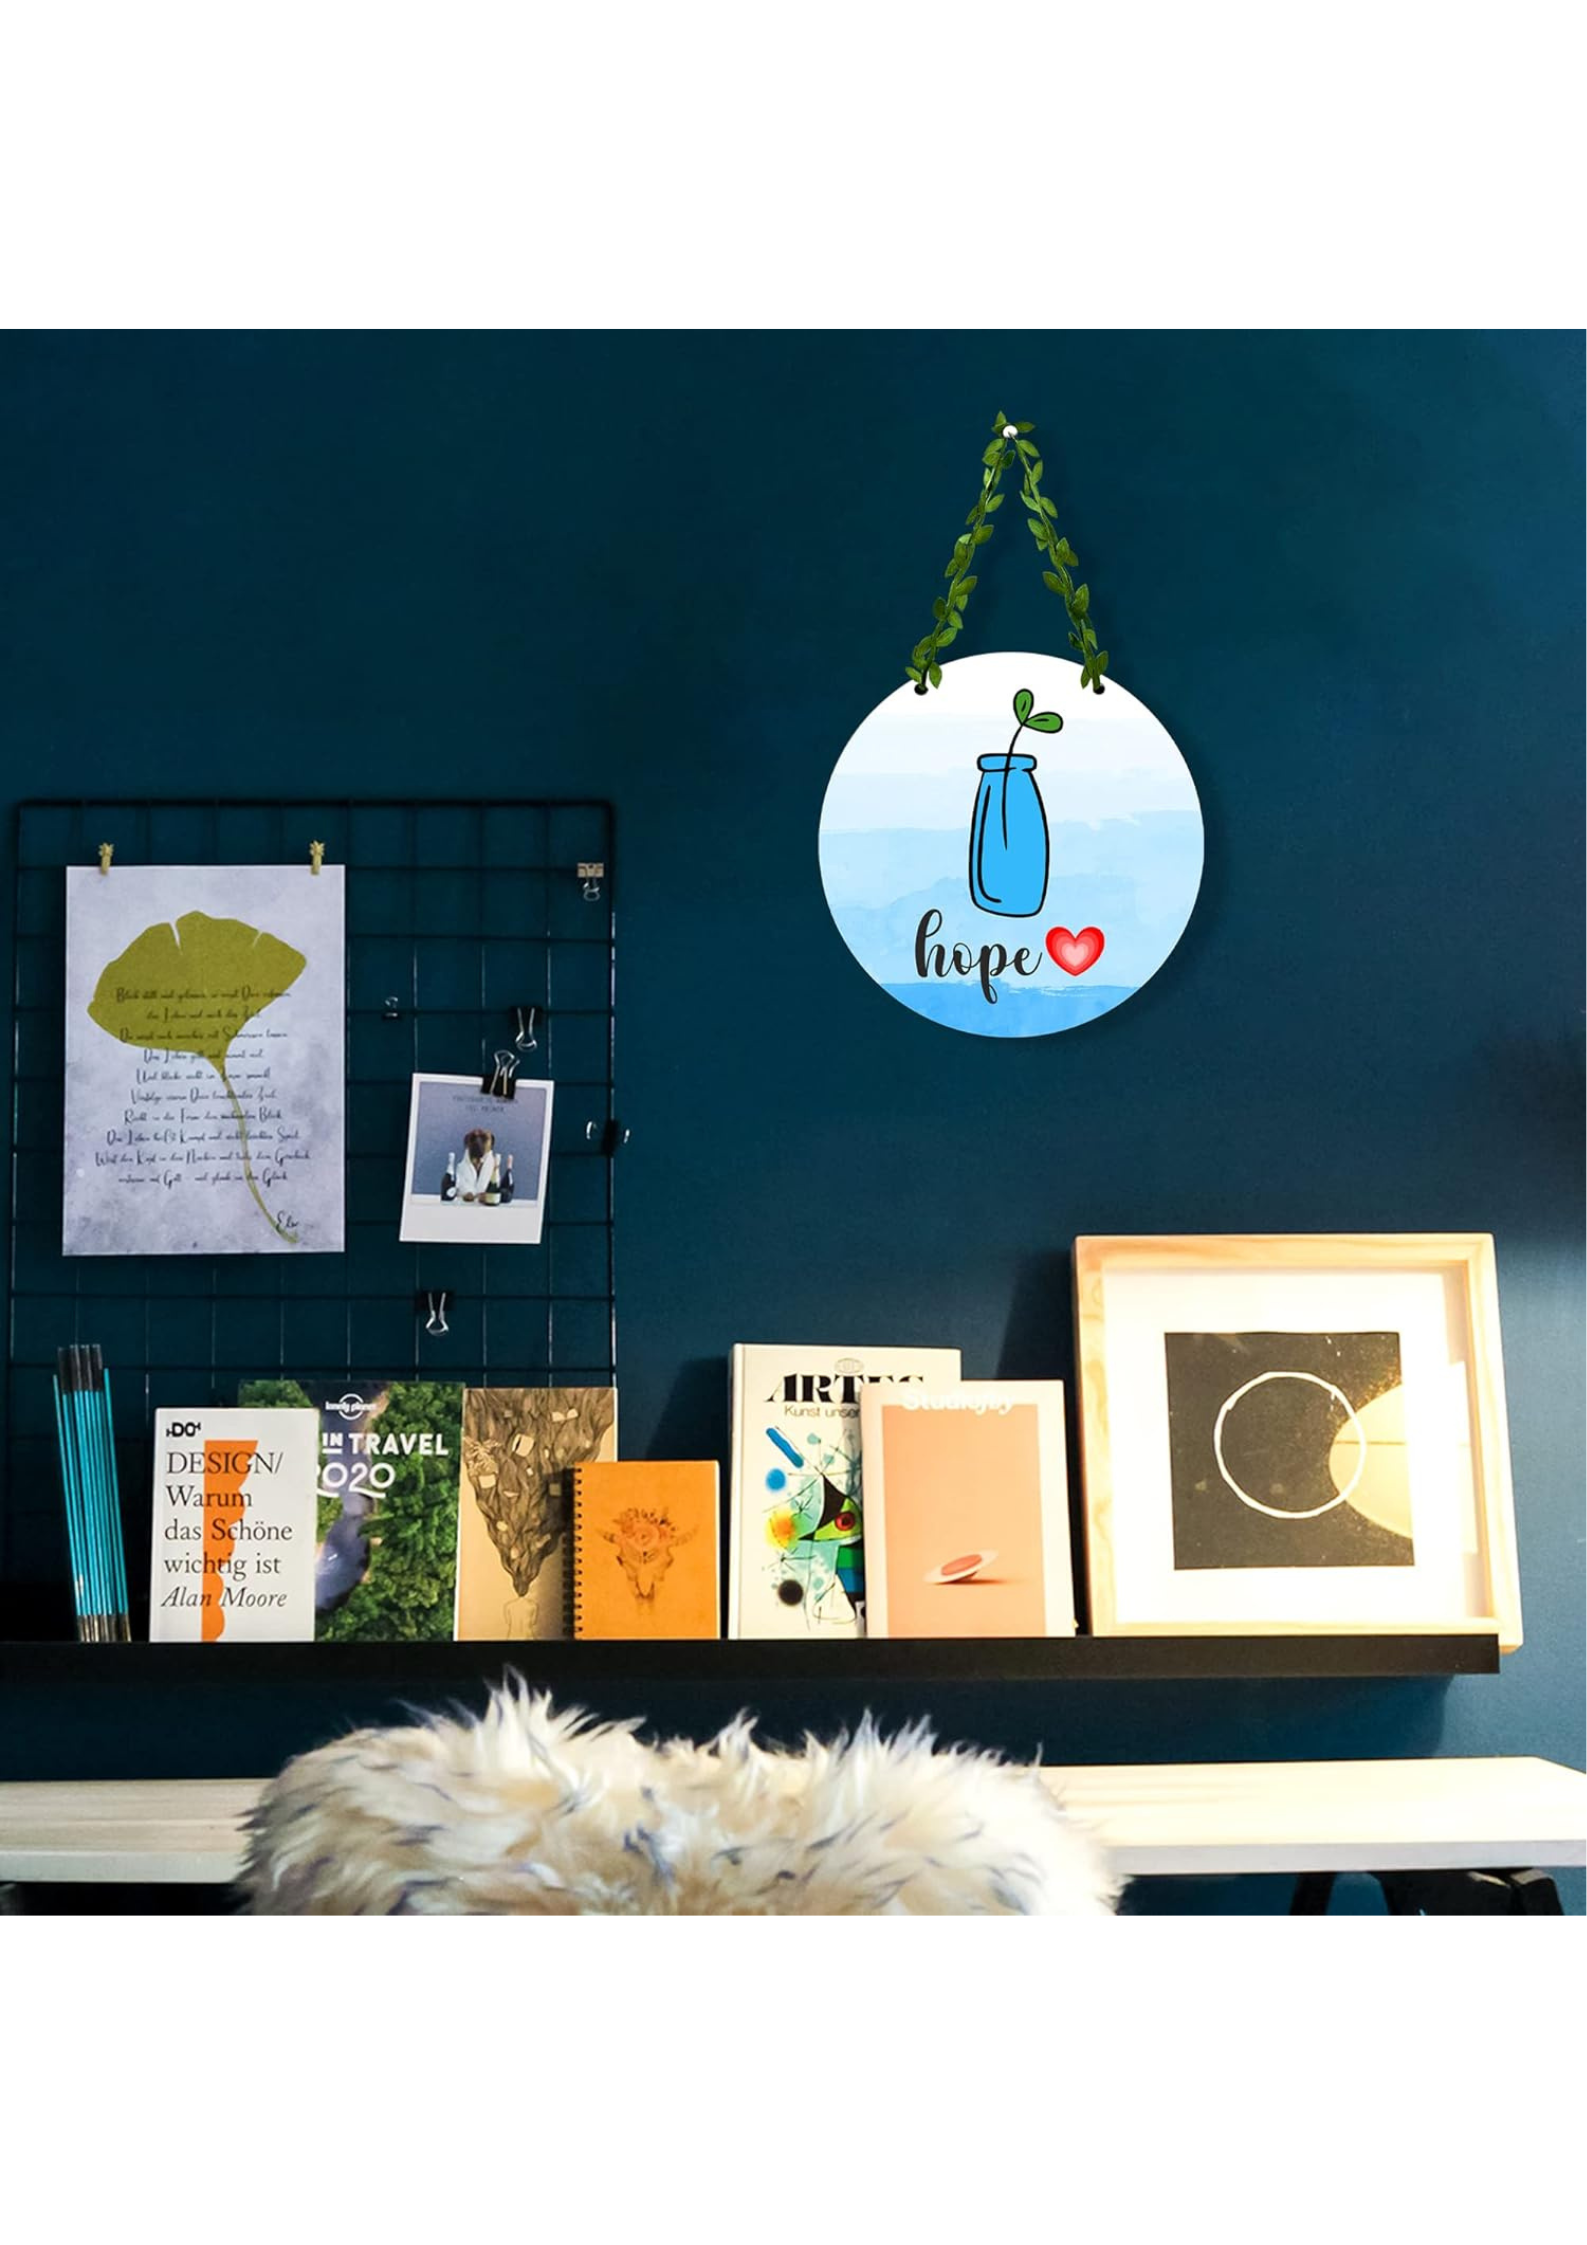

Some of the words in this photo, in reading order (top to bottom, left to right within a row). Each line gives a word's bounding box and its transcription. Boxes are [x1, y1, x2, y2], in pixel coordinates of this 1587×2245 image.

[915, 908, 1043, 1004] hope
[765, 1372, 924, 1404] ART
[784, 1404, 821, 1418] Kunst
[322, 1432, 343, 1453] IN
[348, 1433, 449, 1455] TRAVEL
[166, 1452, 284, 1475] DESIGN/
[166, 1484, 253, 1508] Warum
[164, 1518, 202, 1541] das
[211, 1518, 293, 1541] Schöne
[164, 1552, 247, 1581] wichtig
[256, 1553, 281, 1574] ist
[160, 1586, 212, 1608] Alan
[220, 1586, 288, 1608] Moore
